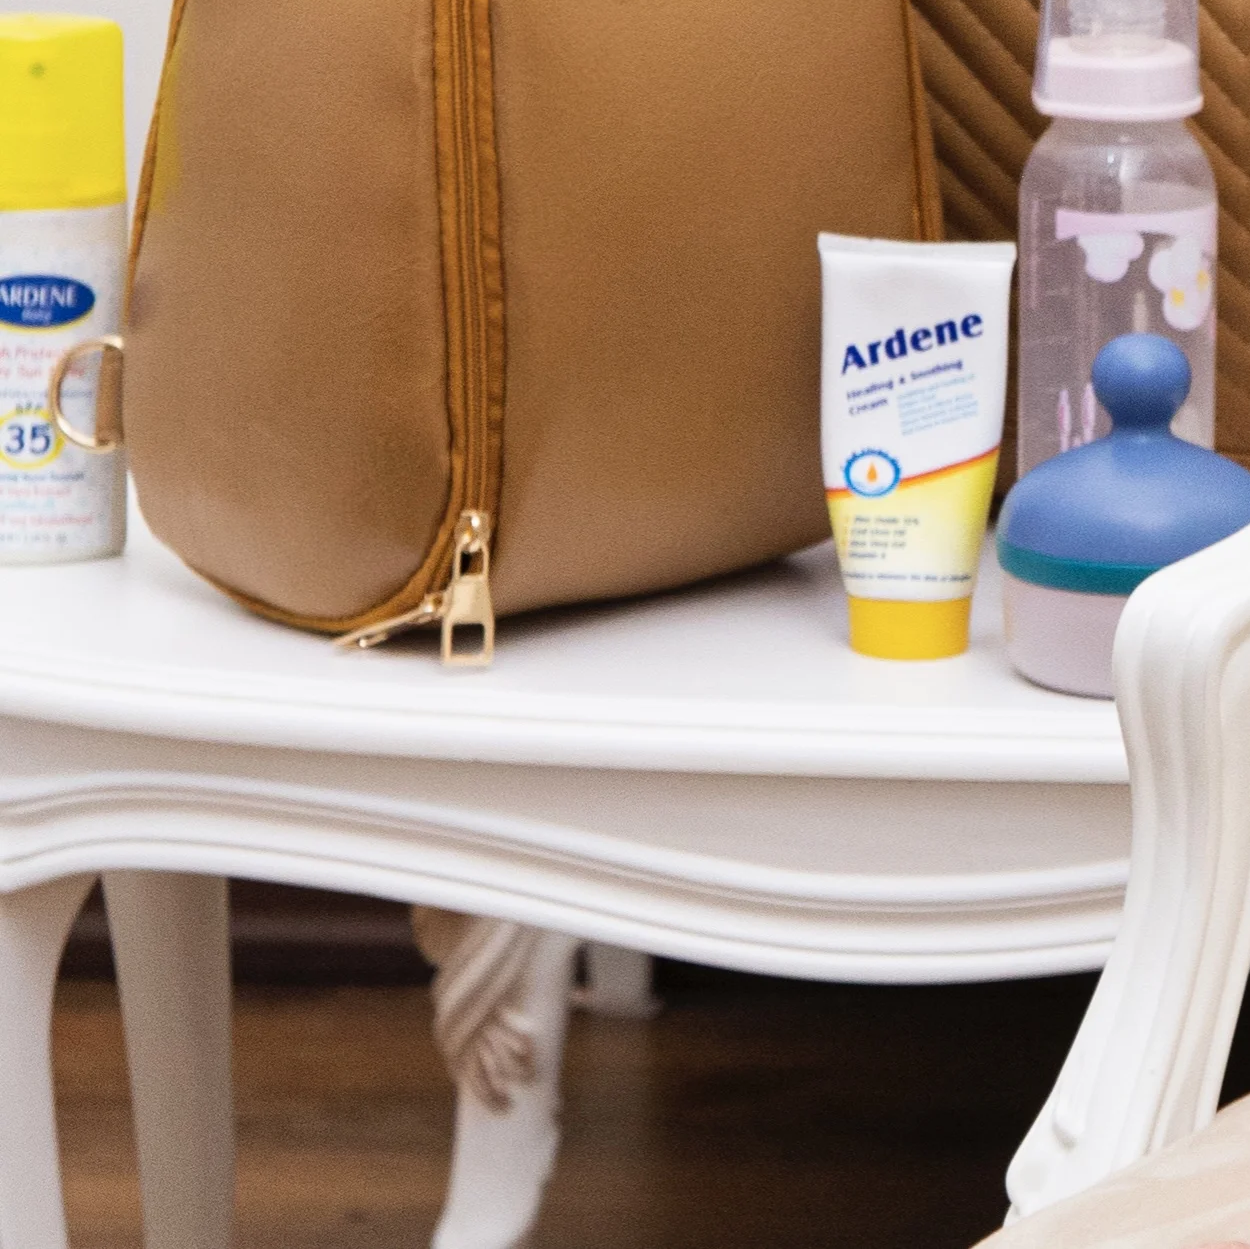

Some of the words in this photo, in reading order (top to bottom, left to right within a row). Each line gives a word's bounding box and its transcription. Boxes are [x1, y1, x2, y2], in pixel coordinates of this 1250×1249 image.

[841, 312, 984, 376] Ardene
[847, 378, 893, 400] Healing
[848, 398, 888, 417] Cream
[4, 422, 52, 456] 35
